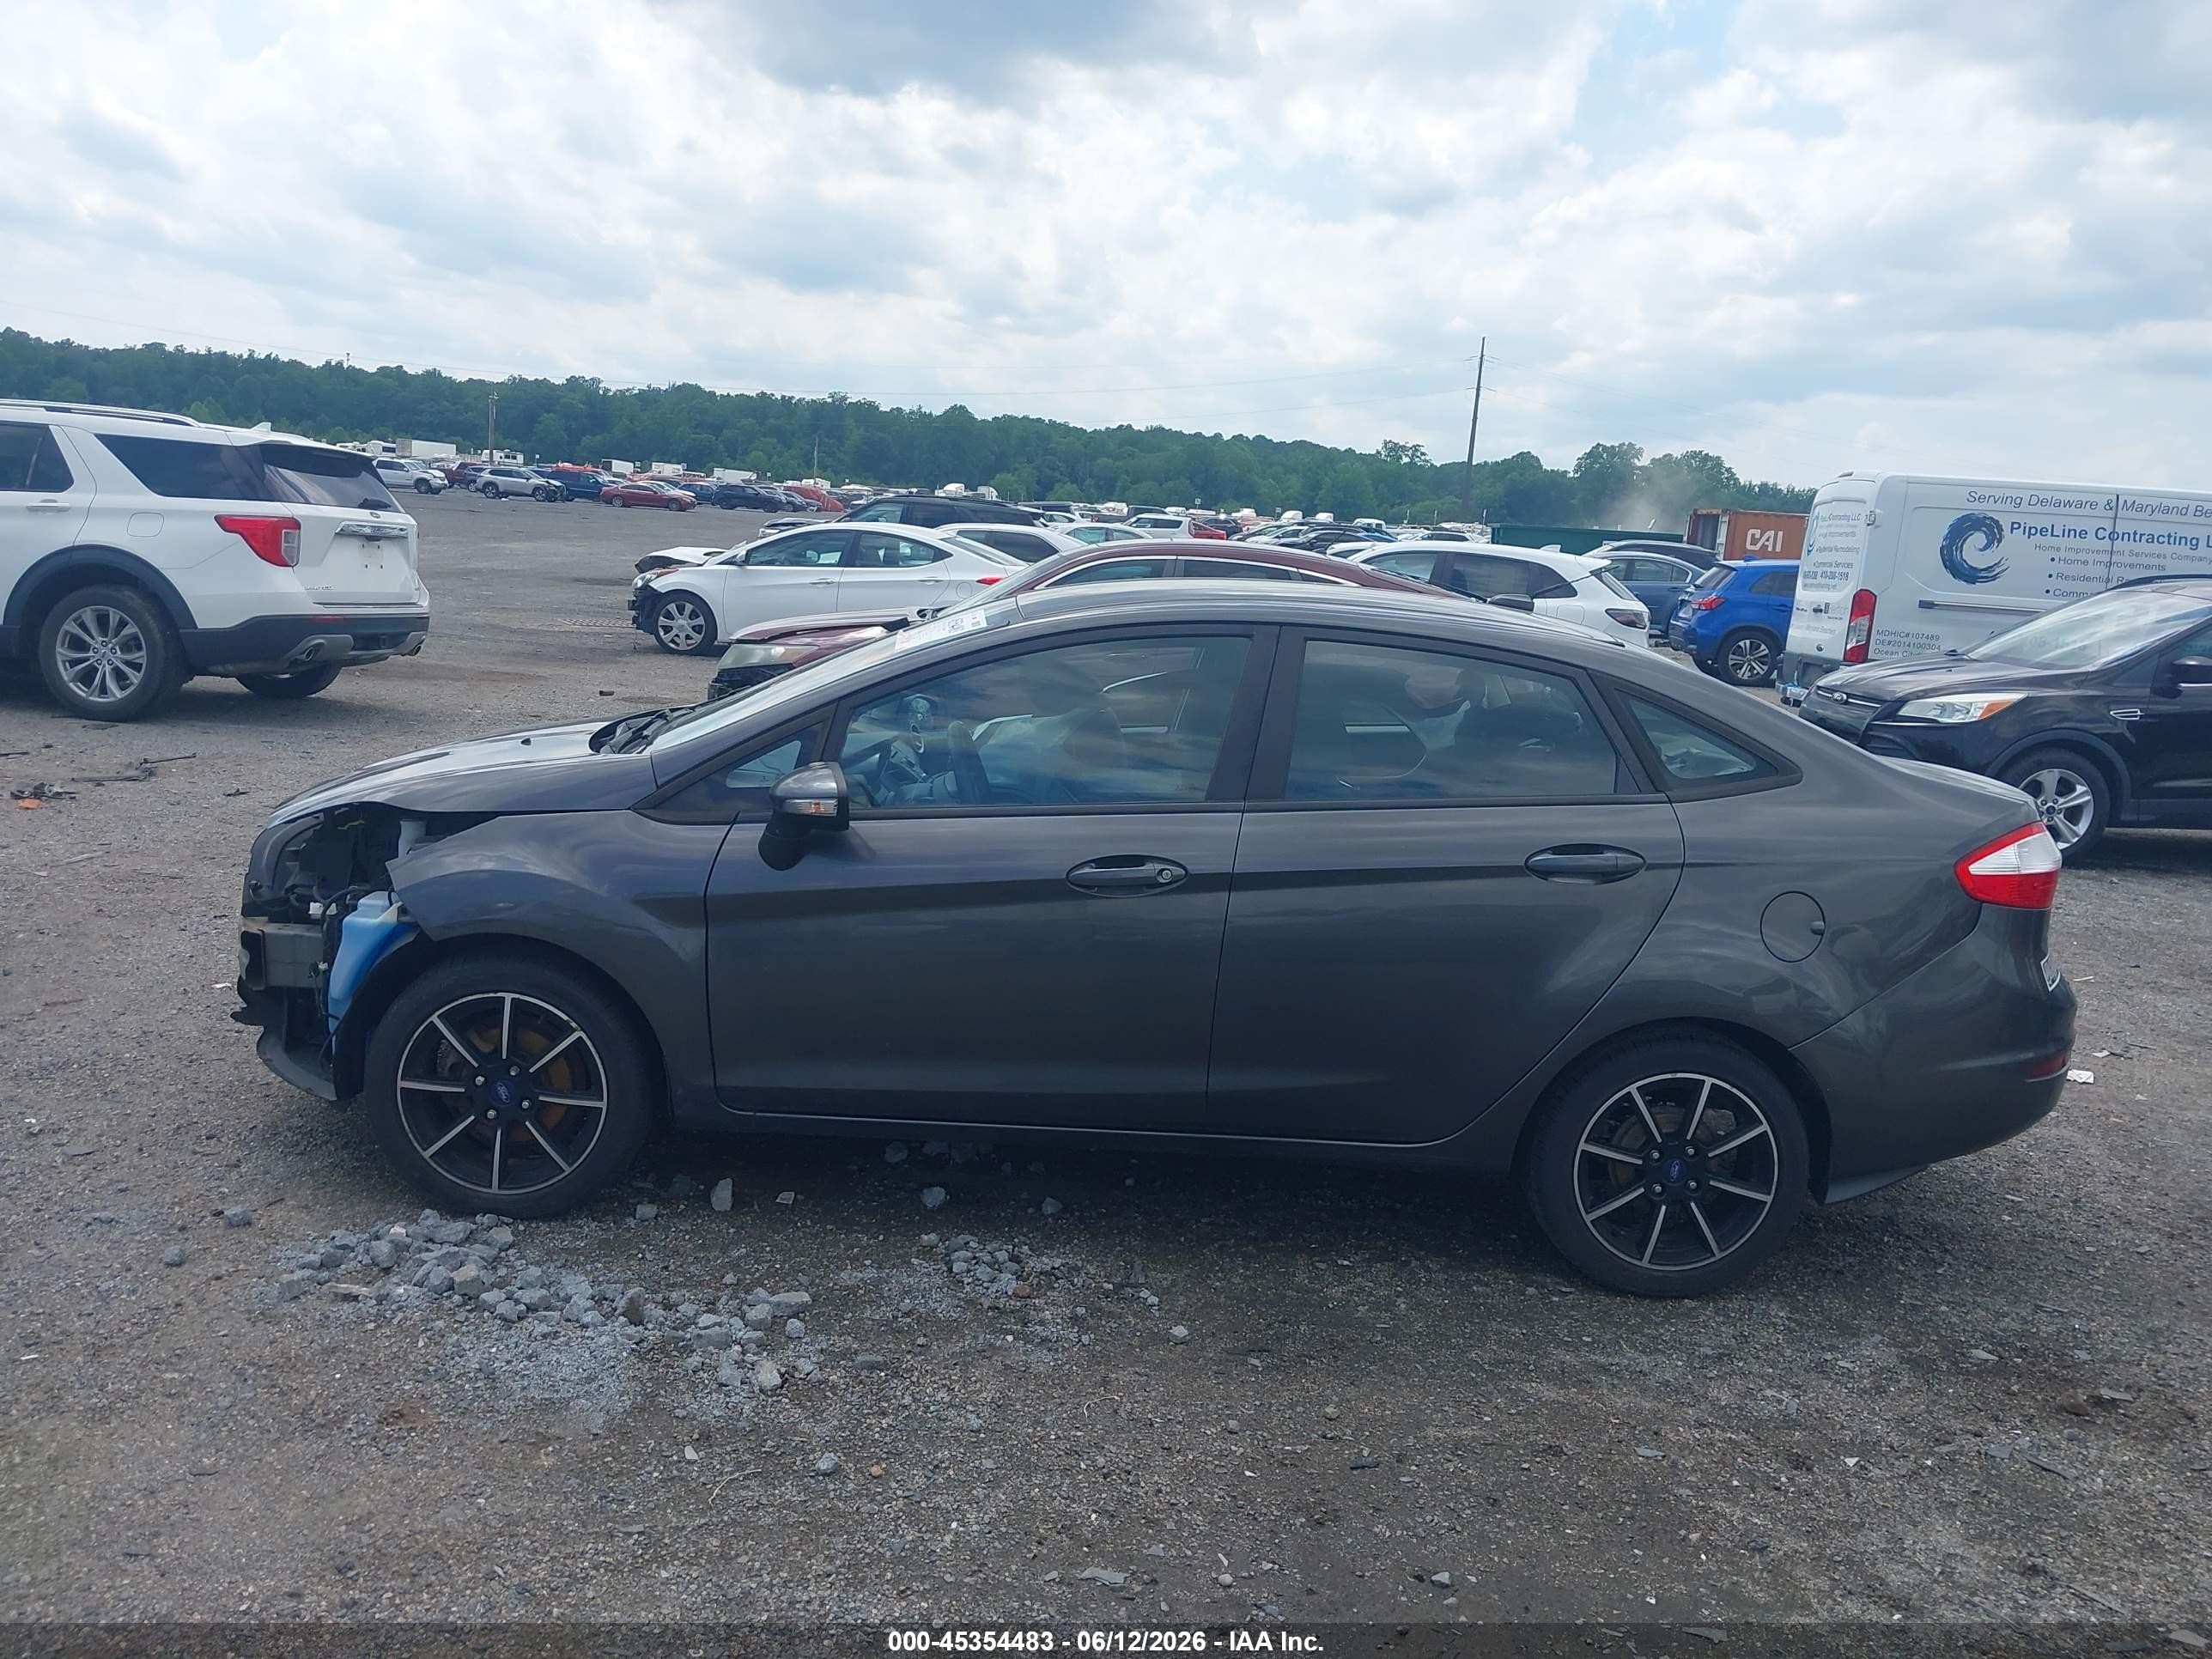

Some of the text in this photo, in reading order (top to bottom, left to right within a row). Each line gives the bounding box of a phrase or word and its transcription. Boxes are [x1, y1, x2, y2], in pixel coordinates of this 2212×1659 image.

[1966, 490, 2023, 508] Serving
[2027, 494, 2098, 510] Delaware
[2104, 498, 2113, 511] &
[2121, 499, 2190, 516] Maryland
[1745, 528, 1784, 552] CAI
[2010, 521, 2087, 540] PipeLine
[2094, 526, 2200, 550] Contracting
[2034, 544, 2061, 552] Home
[2064, 544, 2125, 557] Improvement
[2128, 549, 2167, 560] Services
[2058, 556, 2166, 571] Home Improvements
[2056, 572, 2113, 584] Residential
[1876, 629, 1940, 641] MDHIC#107489
[1874, 647, 1899, 657] Ocean
[1875, 638, 1941, 651] DE#2014100304
